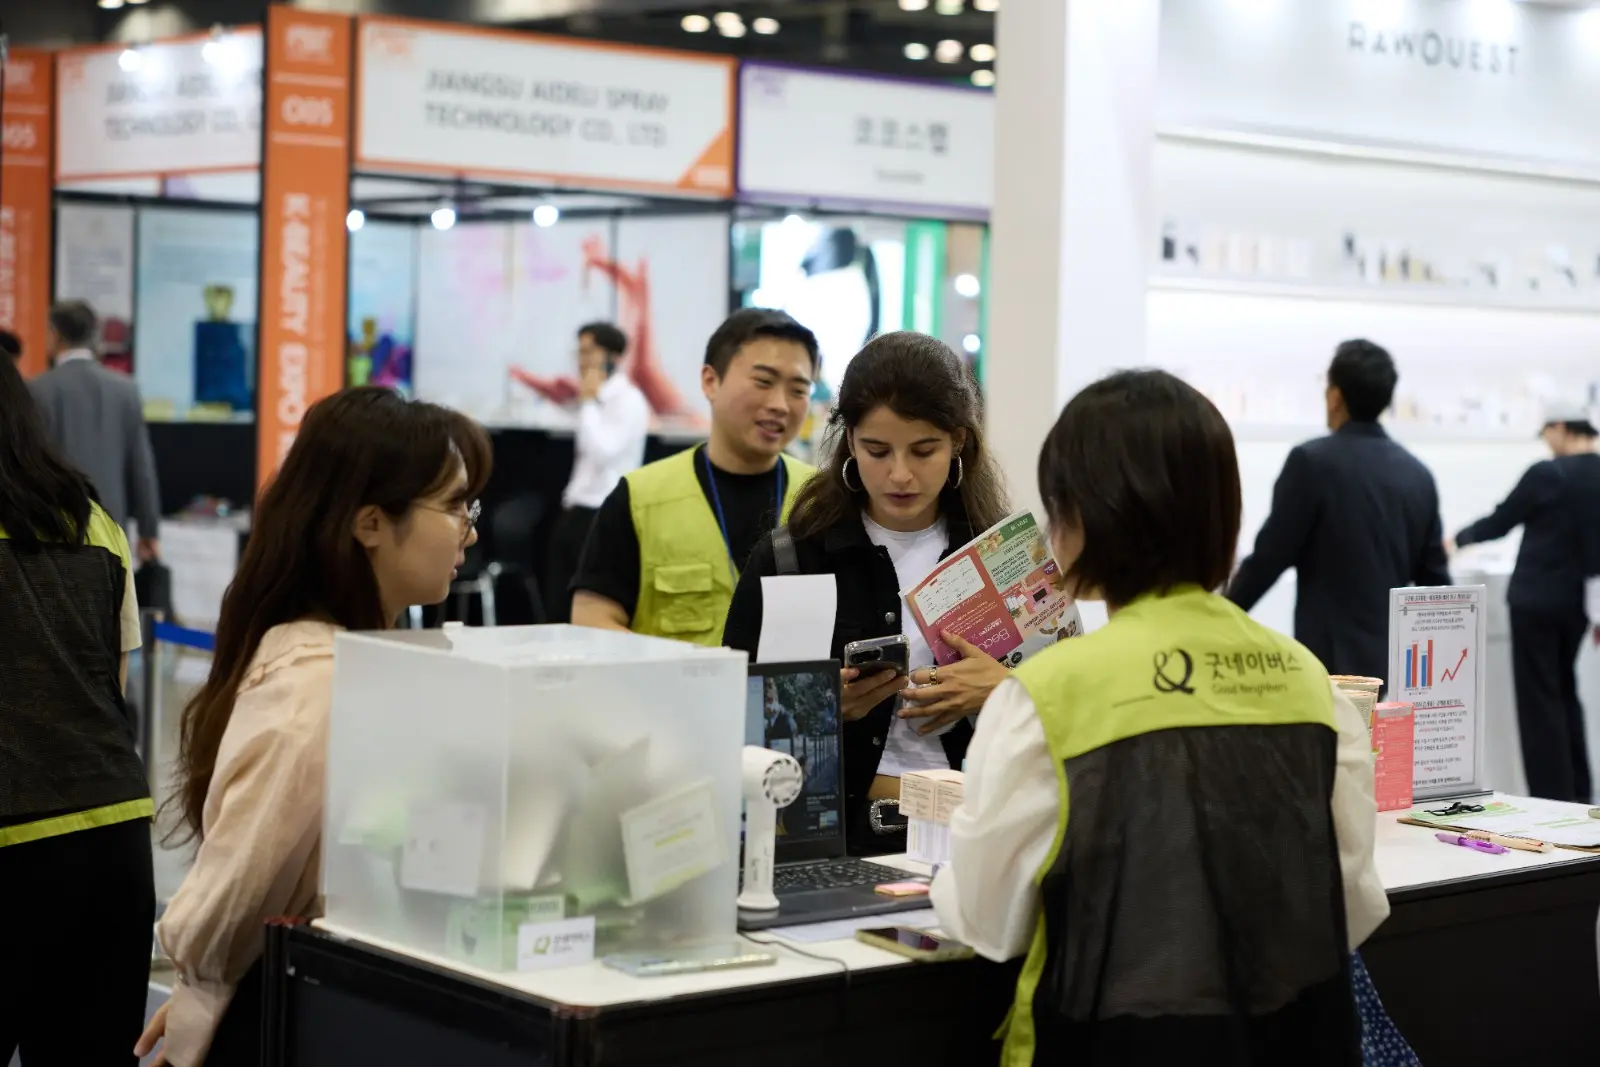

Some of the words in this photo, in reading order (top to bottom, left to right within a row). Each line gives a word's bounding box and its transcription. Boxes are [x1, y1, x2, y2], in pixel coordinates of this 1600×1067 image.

[1348, 22, 1519, 75] RAWQUEST
[426, 69, 524, 99] JIANGSU
[606, 87, 670, 112] SPRAY
[425, 102, 574, 137] TECHNOLOGY
[280, 193, 310, 336] K-BEAUTY
[277, 342, 307, 425] EXPO
[1204, 652, 1302, 680] 굿네이버스
